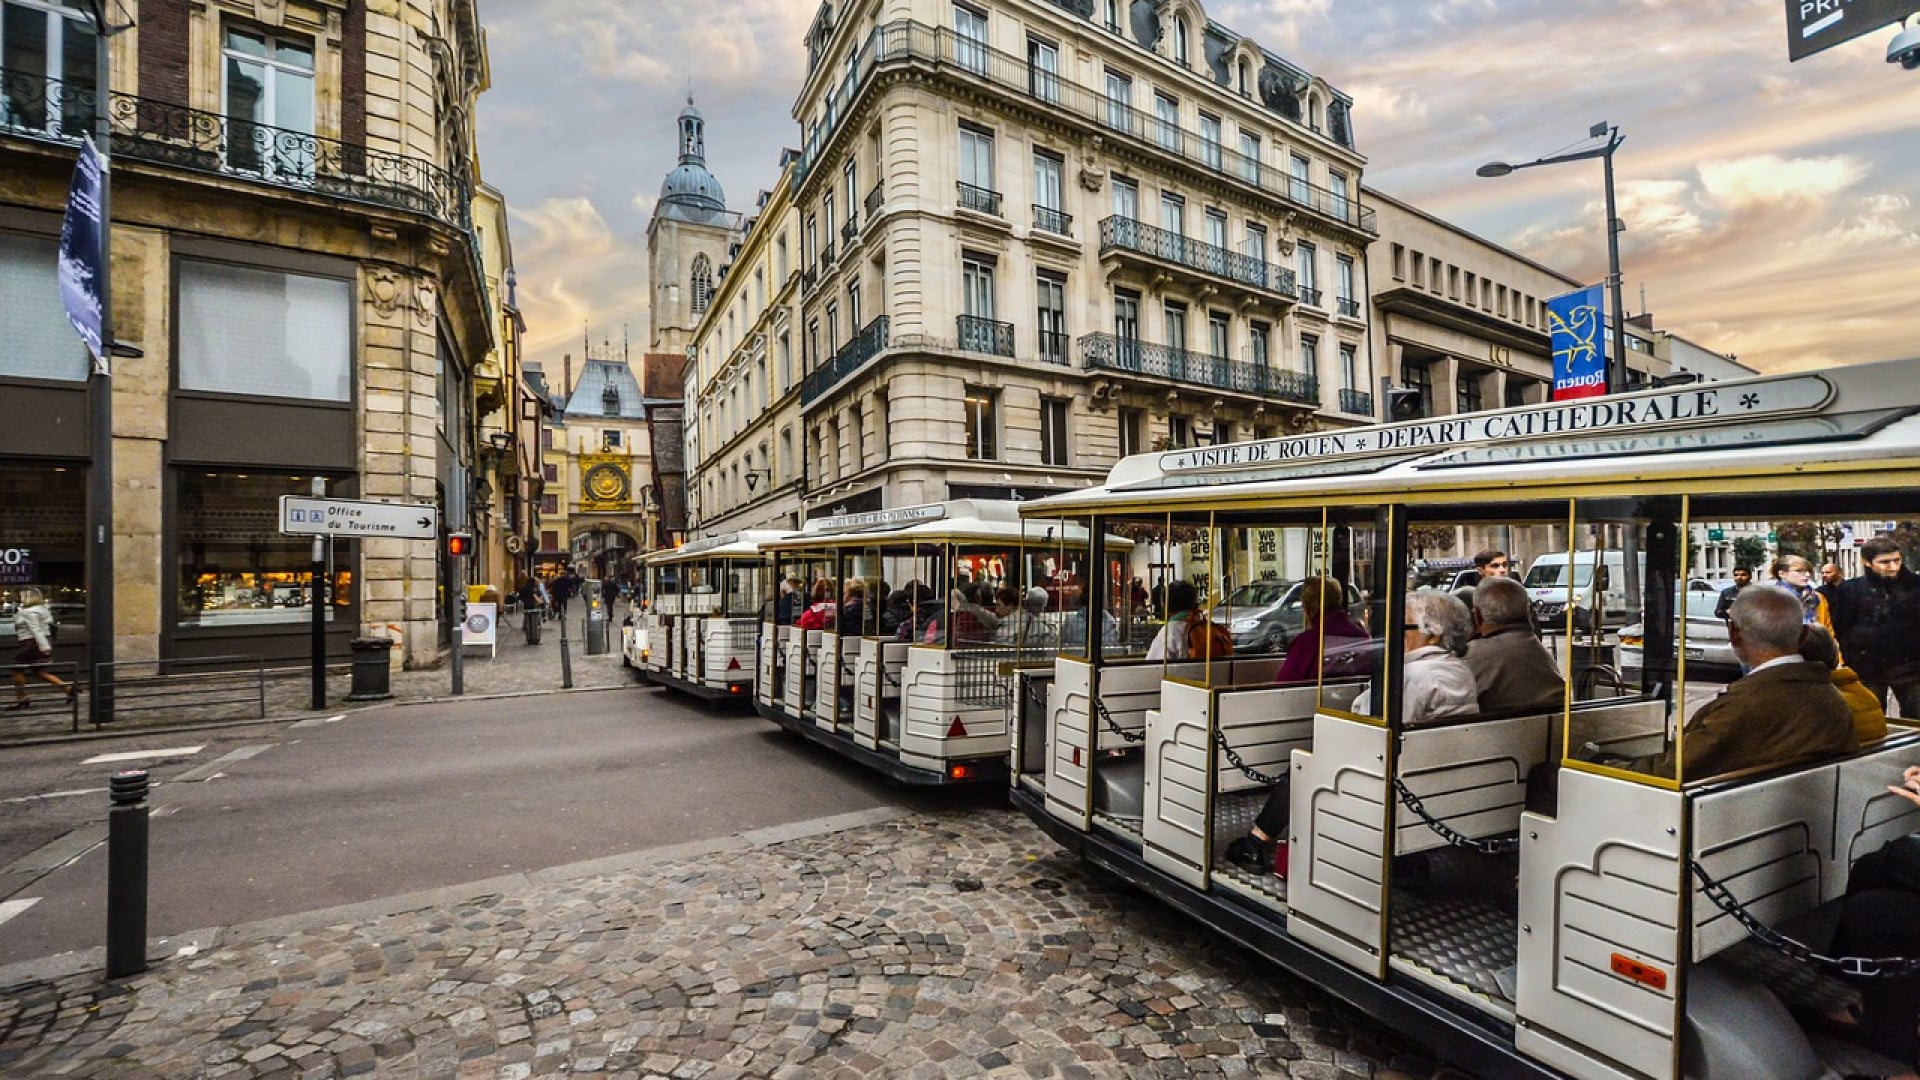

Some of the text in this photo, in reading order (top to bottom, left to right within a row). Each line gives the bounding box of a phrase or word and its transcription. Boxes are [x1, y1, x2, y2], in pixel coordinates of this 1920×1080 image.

[1191, 390, 1719, 467] VISITE DE ROUEN DEPART CATHEDRALE
[327, 506, 362, 517] Office
[327, 520, 396, 532] du Tourisme
[1258, 530, 1275, 541] we
[1190, 542, 1209, 554] are
[1258, 541, 1276, 553] are
[1260, 569, 1277, 581] we
